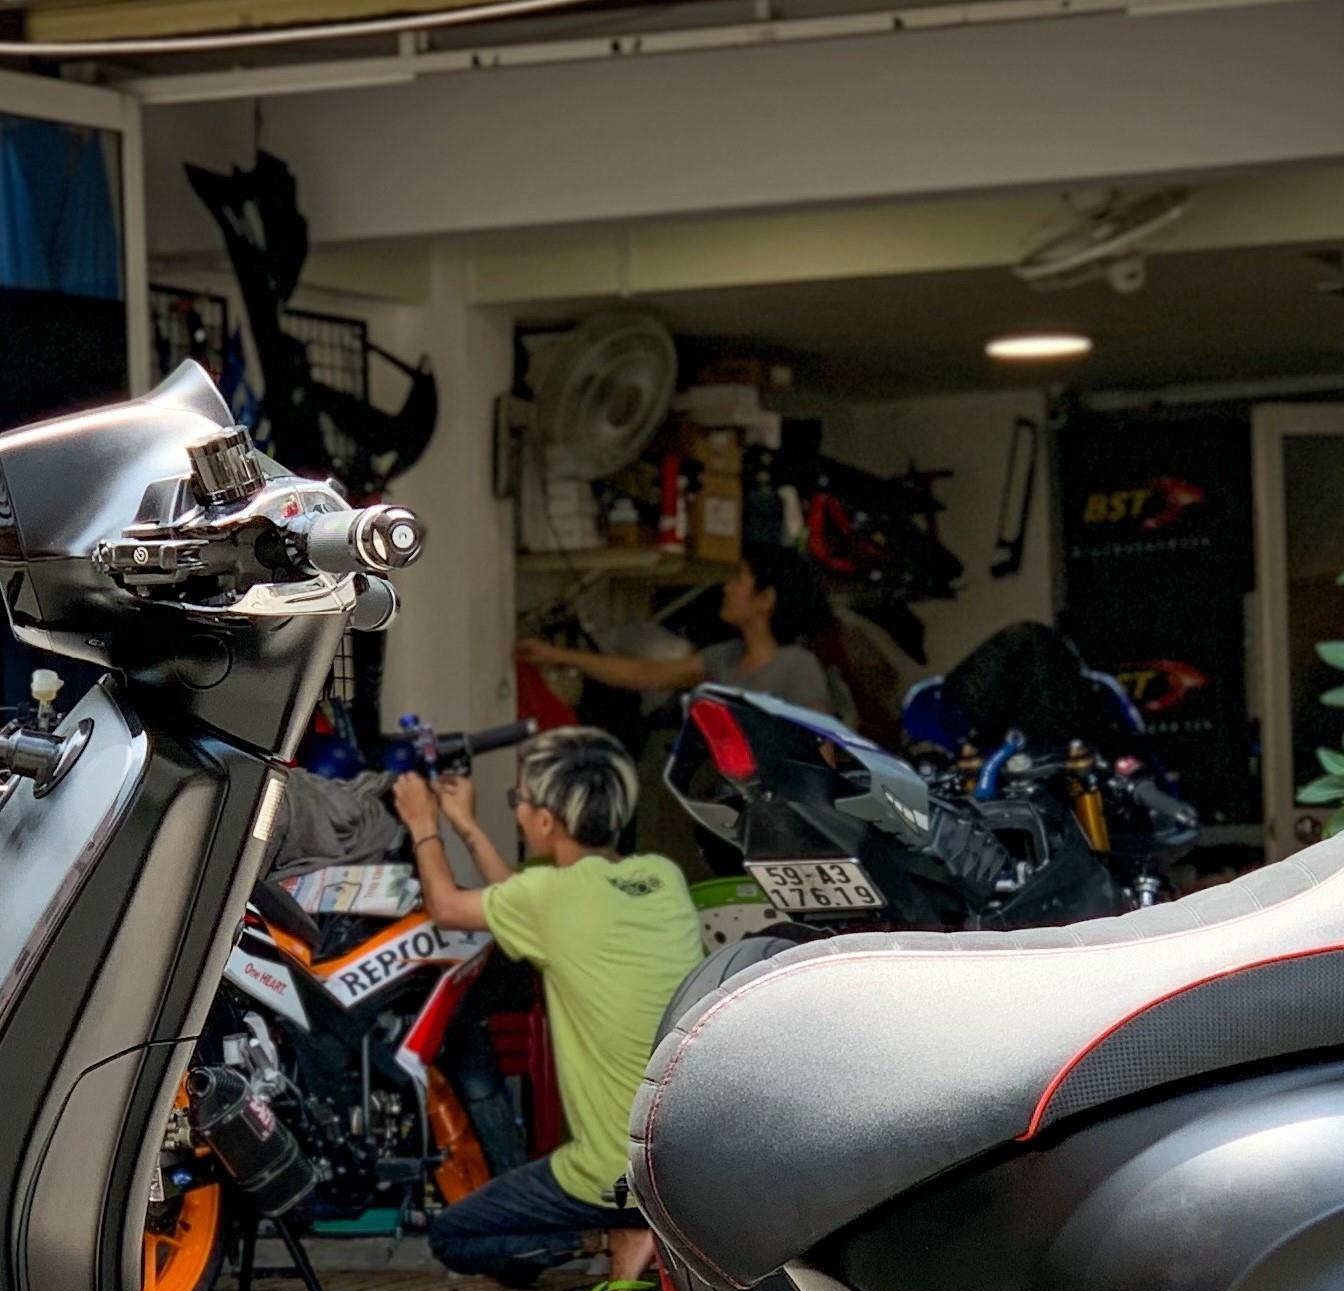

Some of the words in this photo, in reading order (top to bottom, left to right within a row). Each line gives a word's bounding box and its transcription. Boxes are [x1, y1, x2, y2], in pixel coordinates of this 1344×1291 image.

[1083, 489, 1152, 525] BST
[766, 865, 851, 886] 59-A3
[771, 886, 875, 907] 176.19
[339, 925, 450, 996] REPSOL
